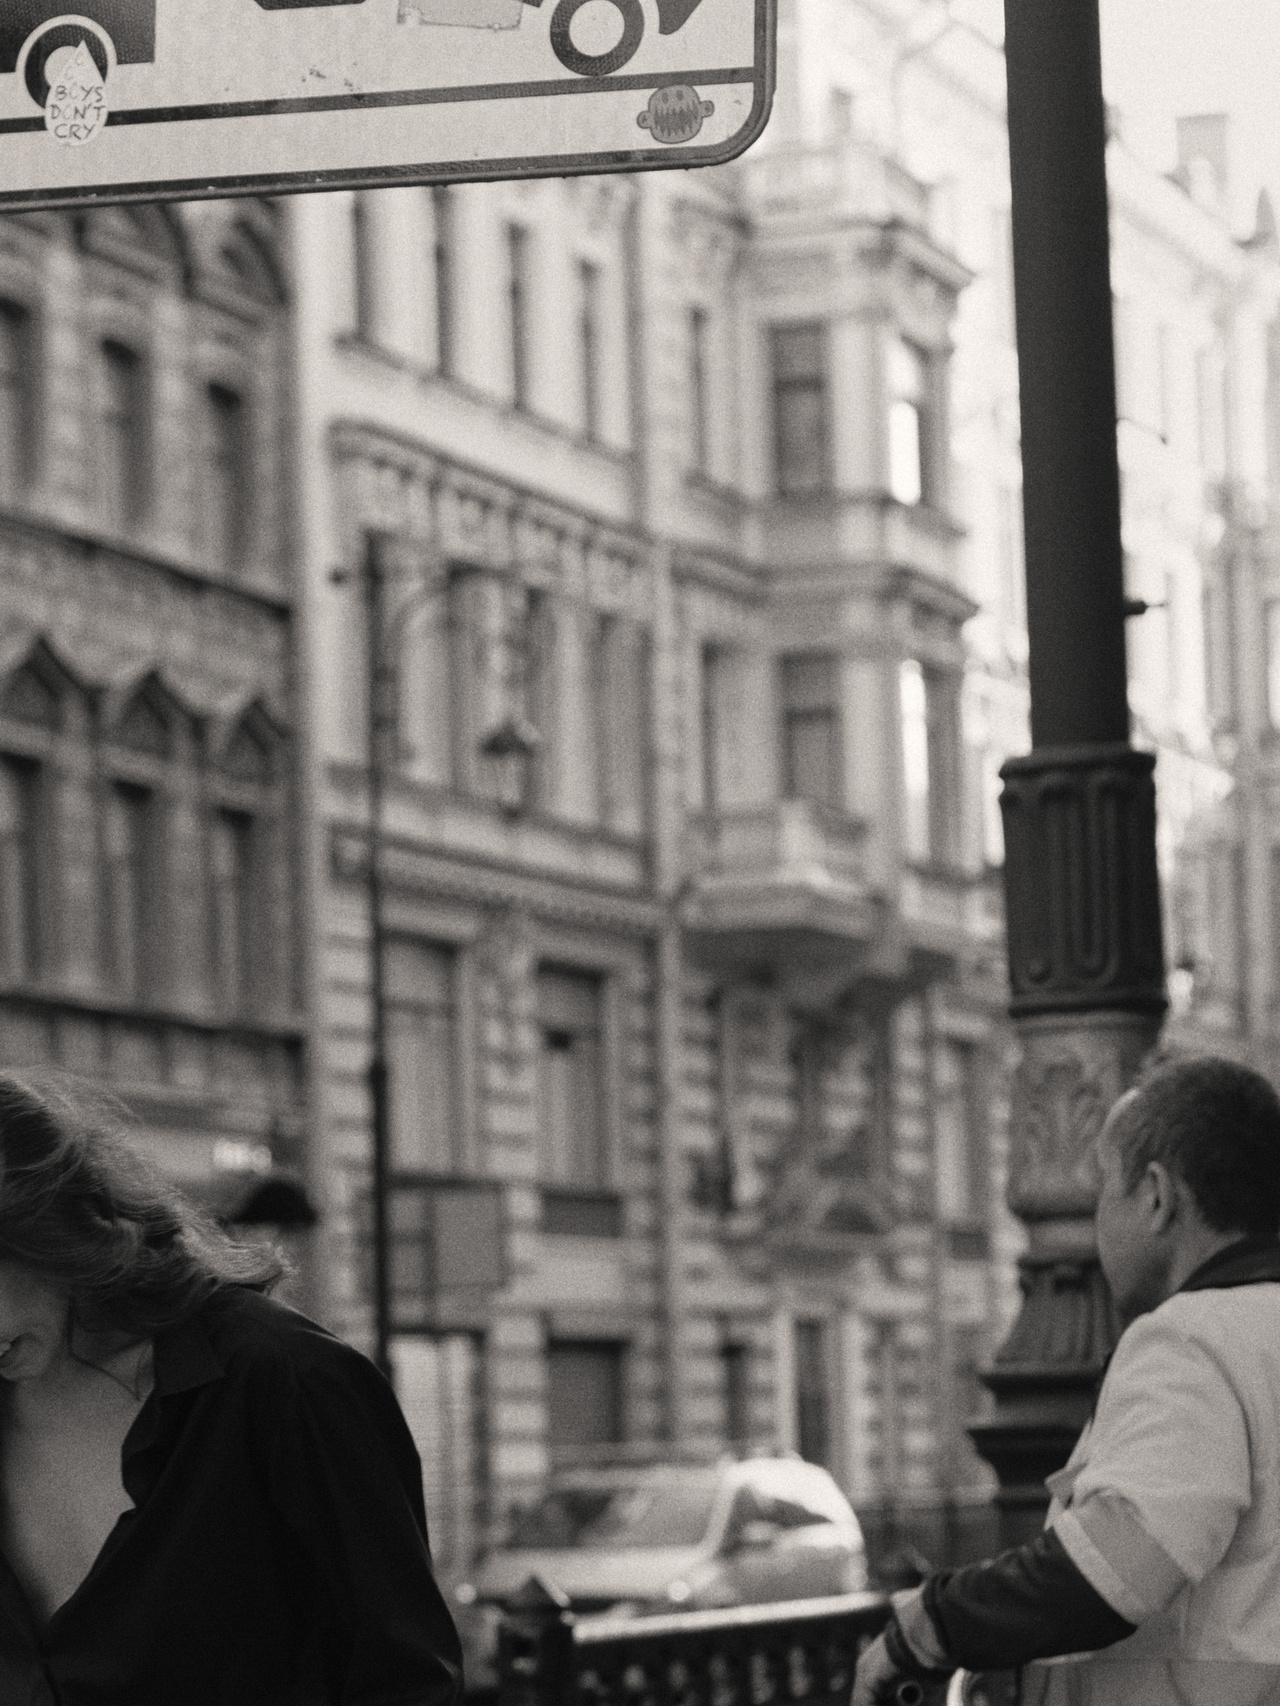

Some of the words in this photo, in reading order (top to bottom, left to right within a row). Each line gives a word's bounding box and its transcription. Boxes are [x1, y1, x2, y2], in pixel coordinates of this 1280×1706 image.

[55, 82, 103, 102] BOYS
[51, 103, 105, 120] DON'T
[54, 123, 95, 140] CRY
